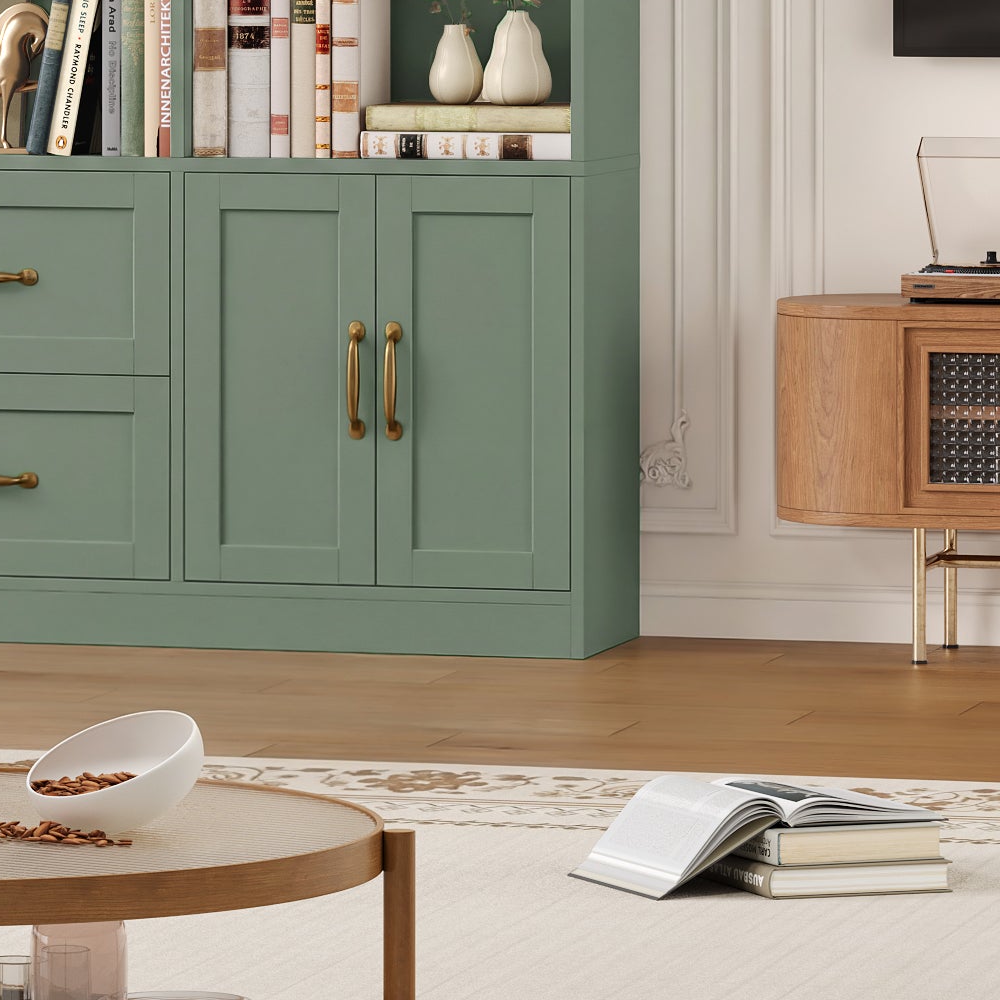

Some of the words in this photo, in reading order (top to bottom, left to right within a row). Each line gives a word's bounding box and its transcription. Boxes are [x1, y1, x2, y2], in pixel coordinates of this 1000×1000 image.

[77, 10, 88, 34] SLEEP
[108, 6, 117, 33] Arad
[235, 32, 256, 40] 1874
[68, 43, 82, 85] RAYMOND
[107, 60, 117, 115] Discipline
[61, 87, 75, 130] CHANDLER
[733, 868, 764, 887] AUSBAU
